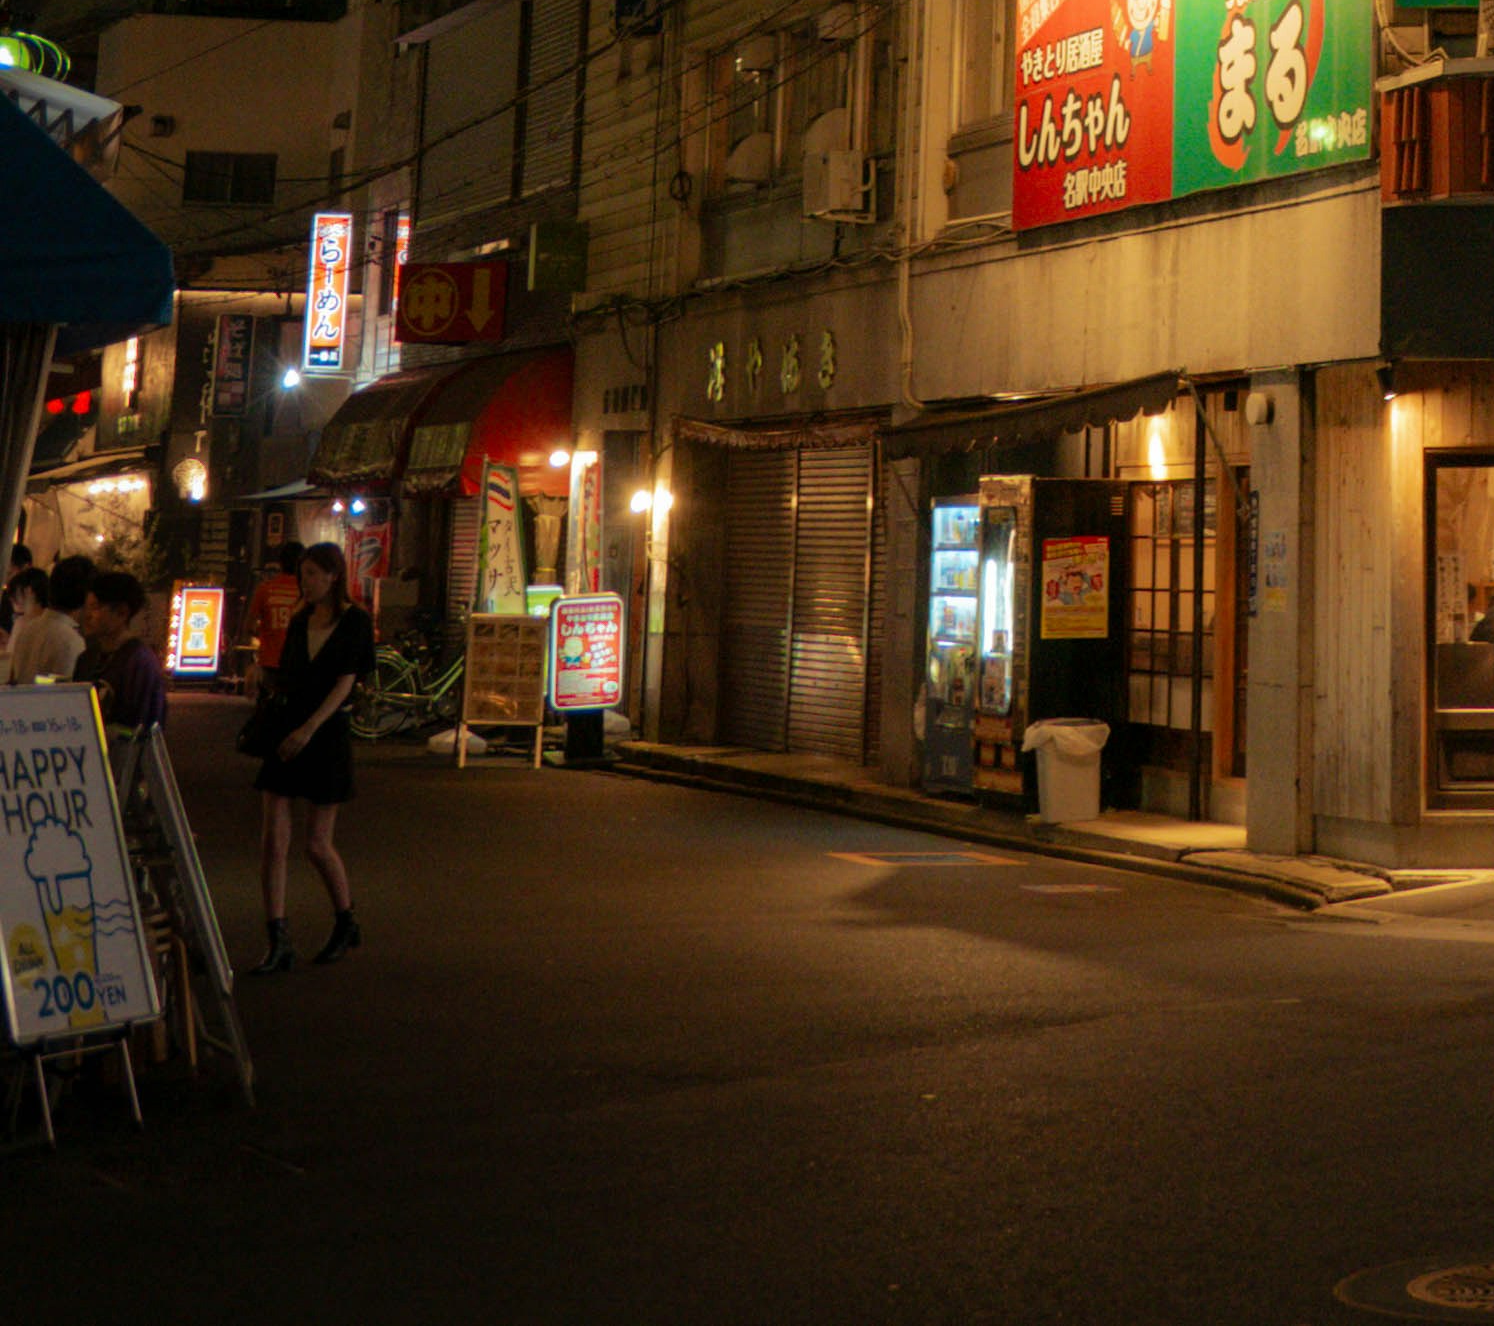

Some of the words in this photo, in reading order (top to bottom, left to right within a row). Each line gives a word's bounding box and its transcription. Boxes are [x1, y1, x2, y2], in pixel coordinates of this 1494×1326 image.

[1019, 28, 1104, 86] やきとり居酒屋
[1017, 73, 1131, 171] しんちゃん
[1062, 159, 1127, 210] 名駅中央店
[313, 237, 342, 341] らーめん
[2, 788, 94, 835] HOUR
[33, 971, 96, 1019] 200
